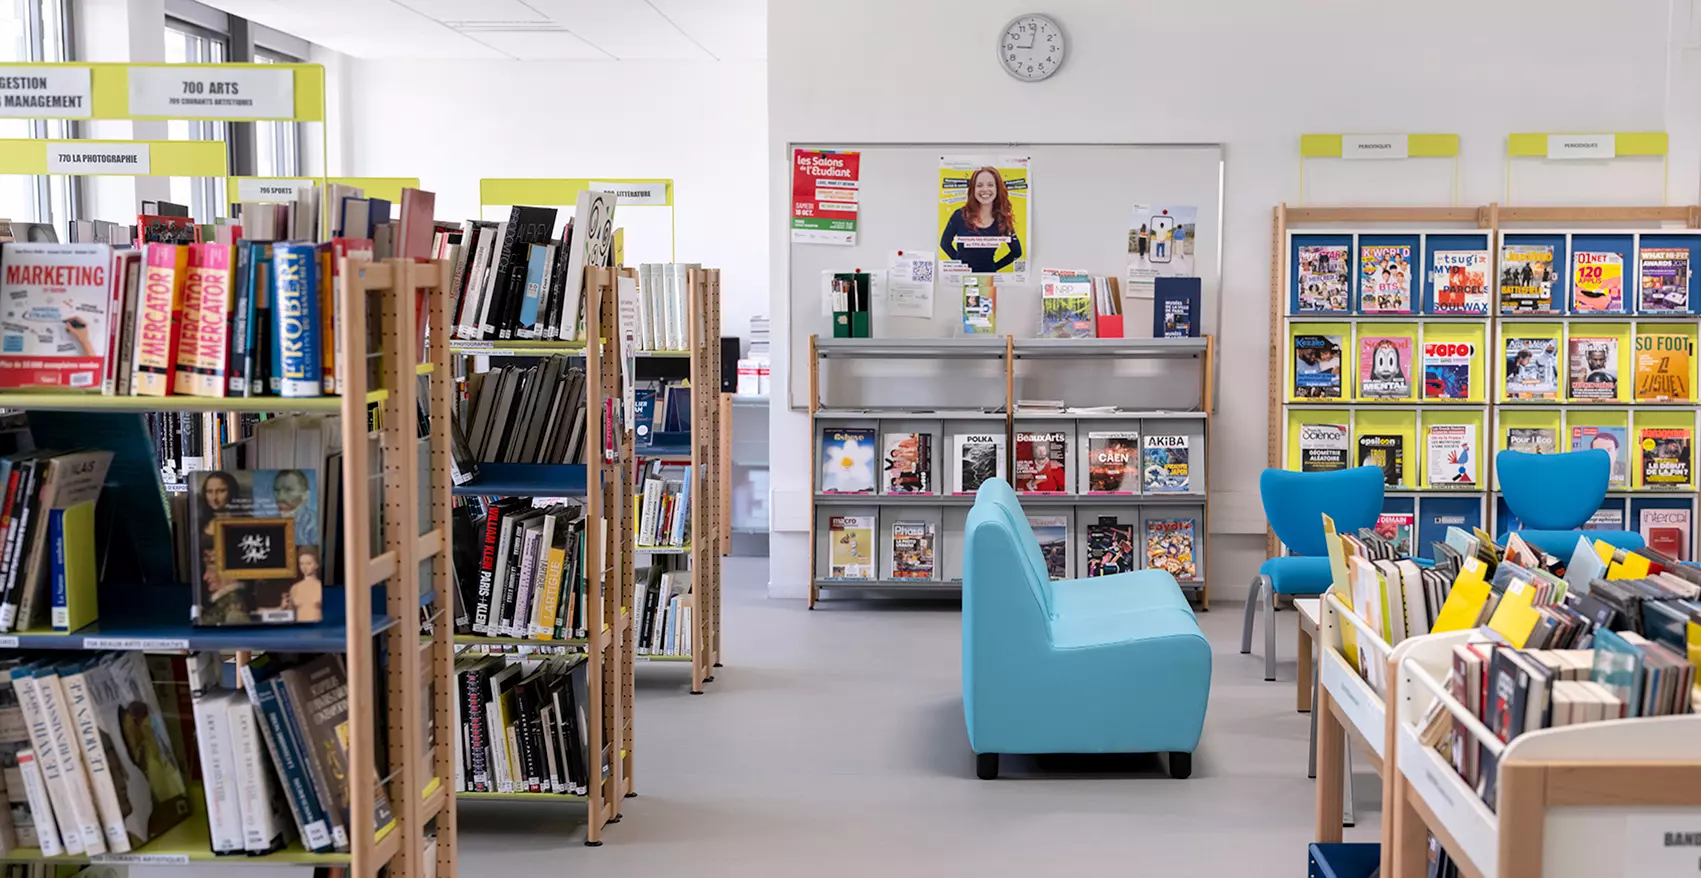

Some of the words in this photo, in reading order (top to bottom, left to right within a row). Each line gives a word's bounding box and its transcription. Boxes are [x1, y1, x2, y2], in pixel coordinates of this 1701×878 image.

[1046, 34, 1052, 42] 2
[1007, 43, 1014, 51] 9
[1010, 54, 1016, 62] 8
[1038, 62, 1044, 70] 5
[182, 82, 204, 94] 700
[209, 82, 239, 95] ARTS
[5, 95, 82, 108] MANAGEMENT
[58, 154, 71, 163] 770
[72, 154, 82, 163] LA
[82, 154, 138, 164] PHOTOGRAPHIE
[812, 156, 844, 166] Salons
[1444, 254, 1478, 264] tsugi
[1434, 265, 1460, 274] MYD
[1578, 266, 1602, 278] 120
[6, 265, 104, 286] MARKETING
[1379, 283, 1398, 291] BTS
[1443, 286, 1488, 294] PARCELS
[1434, 302, 1488, 312] SOULWAX
[141, 272, 172, 359] MERCATOR
[199, 273, 225, 360] MERCATOR
[1636, 336, 1652, 350] SO
[1657, 336, 1688, 350] FOOT
[1364, 382, 1407, 391] MENTAL
[1302, 428, 1340, 440] Science
[1510, 436, 1530, 444] Pour
[486, 506, 500, 540] WILLIAM
[1380, 516, 1406, 524] DEMAIN
[894, 526, 924, 536] Photo
[482, 540, 496, 571] KLEIN
[478, 570, 492, 597] PARIS
[543, 561, 560, 620] LARTIGUE
[91, 759, 105, 773] LE
[44, 763, 60, 780] LE
